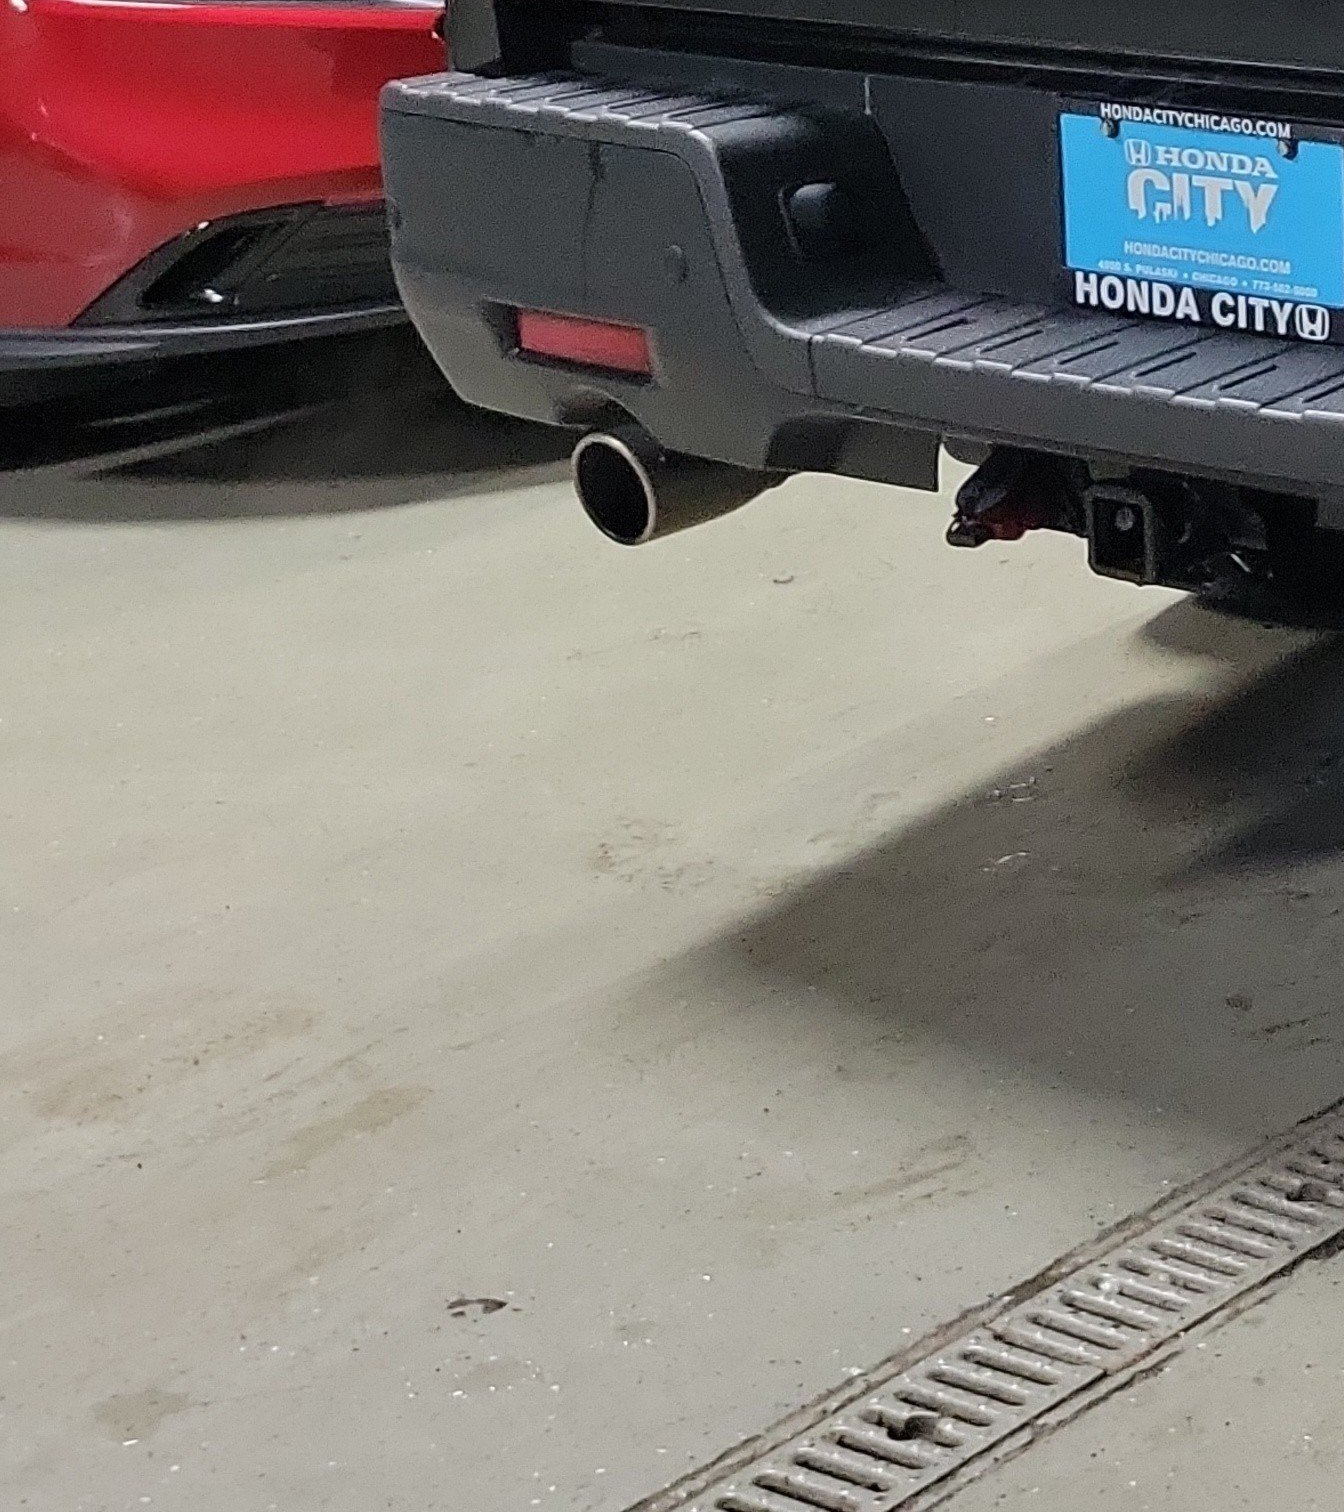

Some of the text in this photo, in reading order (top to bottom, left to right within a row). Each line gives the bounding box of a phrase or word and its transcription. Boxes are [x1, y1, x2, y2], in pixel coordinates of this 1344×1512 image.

[1100, 102, 1291, 138] HONDACITYCHICAGO.COM
[1155, 145, 1278, 178] HONDA
[1127, 168, 1280, 234] CITY
[1123, 240, 1291, 275] HONDACITYCHICAGO.COM
[1191, 270, 1238, 286] CHICAGO
[1075, 271, 1299, 336] HONDA CITY
